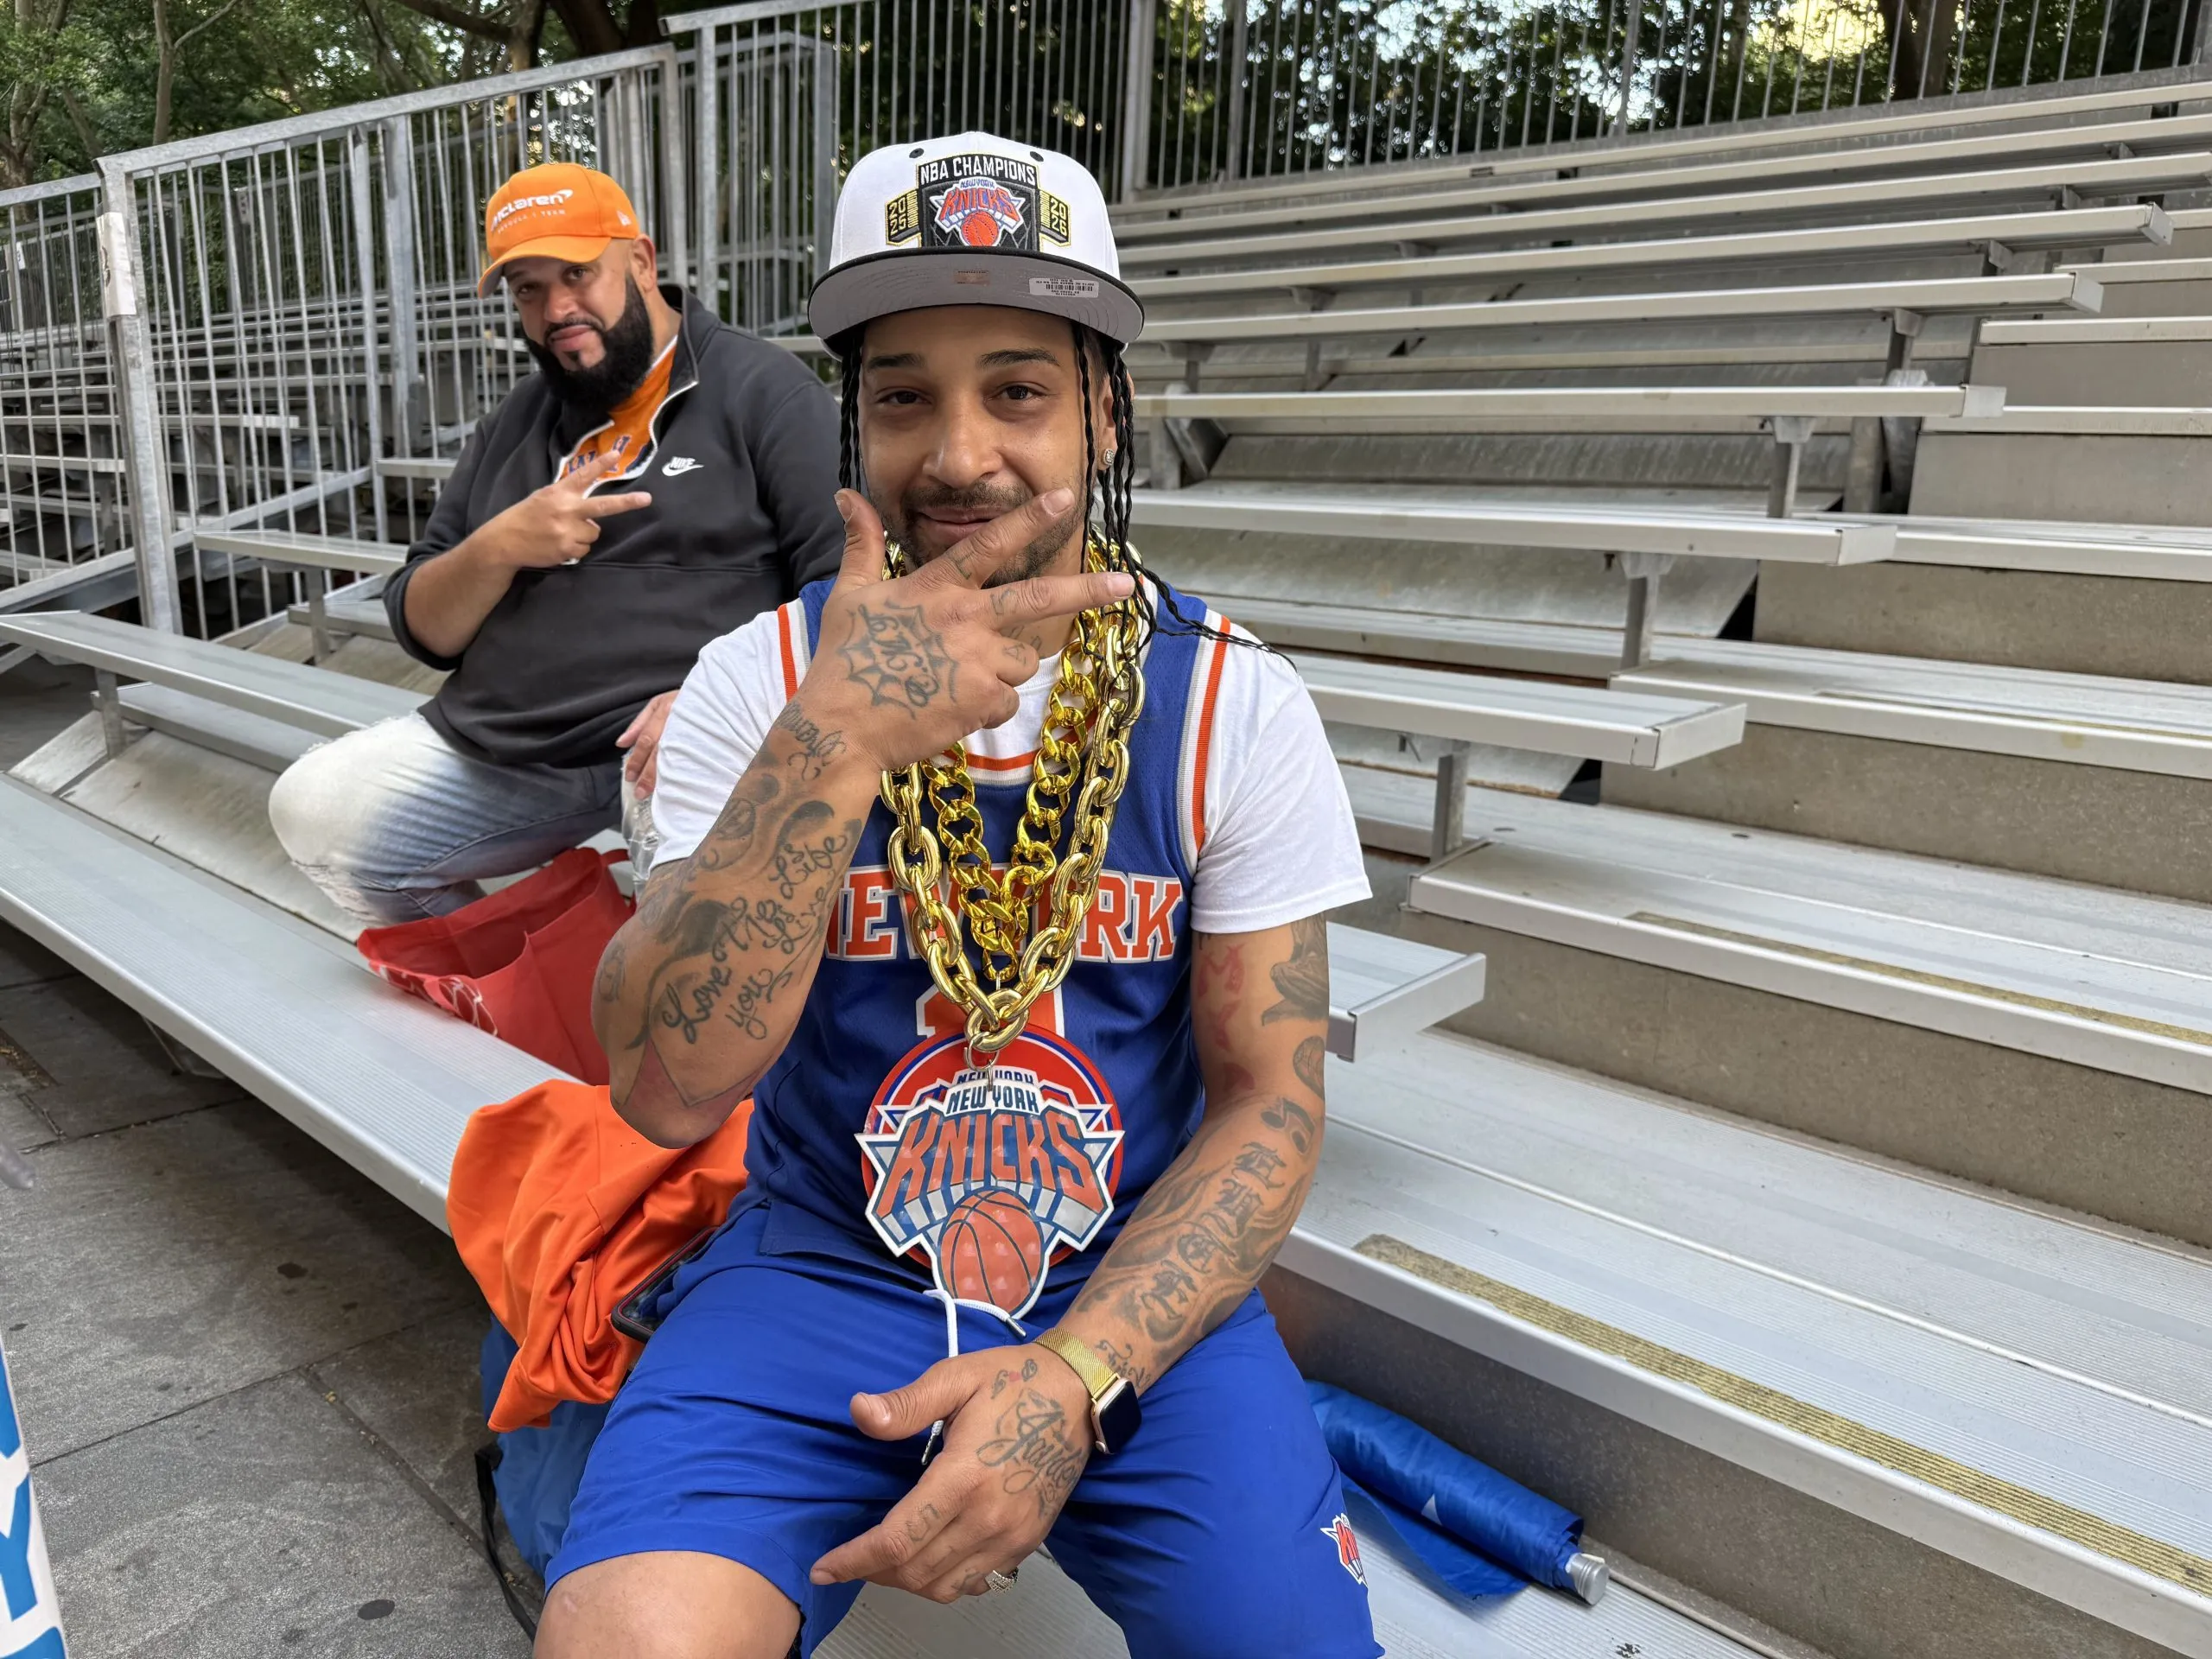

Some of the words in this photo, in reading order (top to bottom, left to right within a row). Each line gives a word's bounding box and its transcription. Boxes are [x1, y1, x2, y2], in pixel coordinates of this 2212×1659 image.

[920, 161, 950, 185] NBA
[953, 155, 1036, 185] CHAMPIONS
[889, 197, 907, 220] 20
[938, 187, 1020, 222] KNICKS
[1049, 197, 1068, 221] 20
[890, 217, 907, 236] 25
[1052, 216, 1068, 236] 26
[945, 1085, 987, 1115] NEW
[992, 1084, 1039, 1114] YORK
[876, 1109, 1109, 1220] KNICKS
